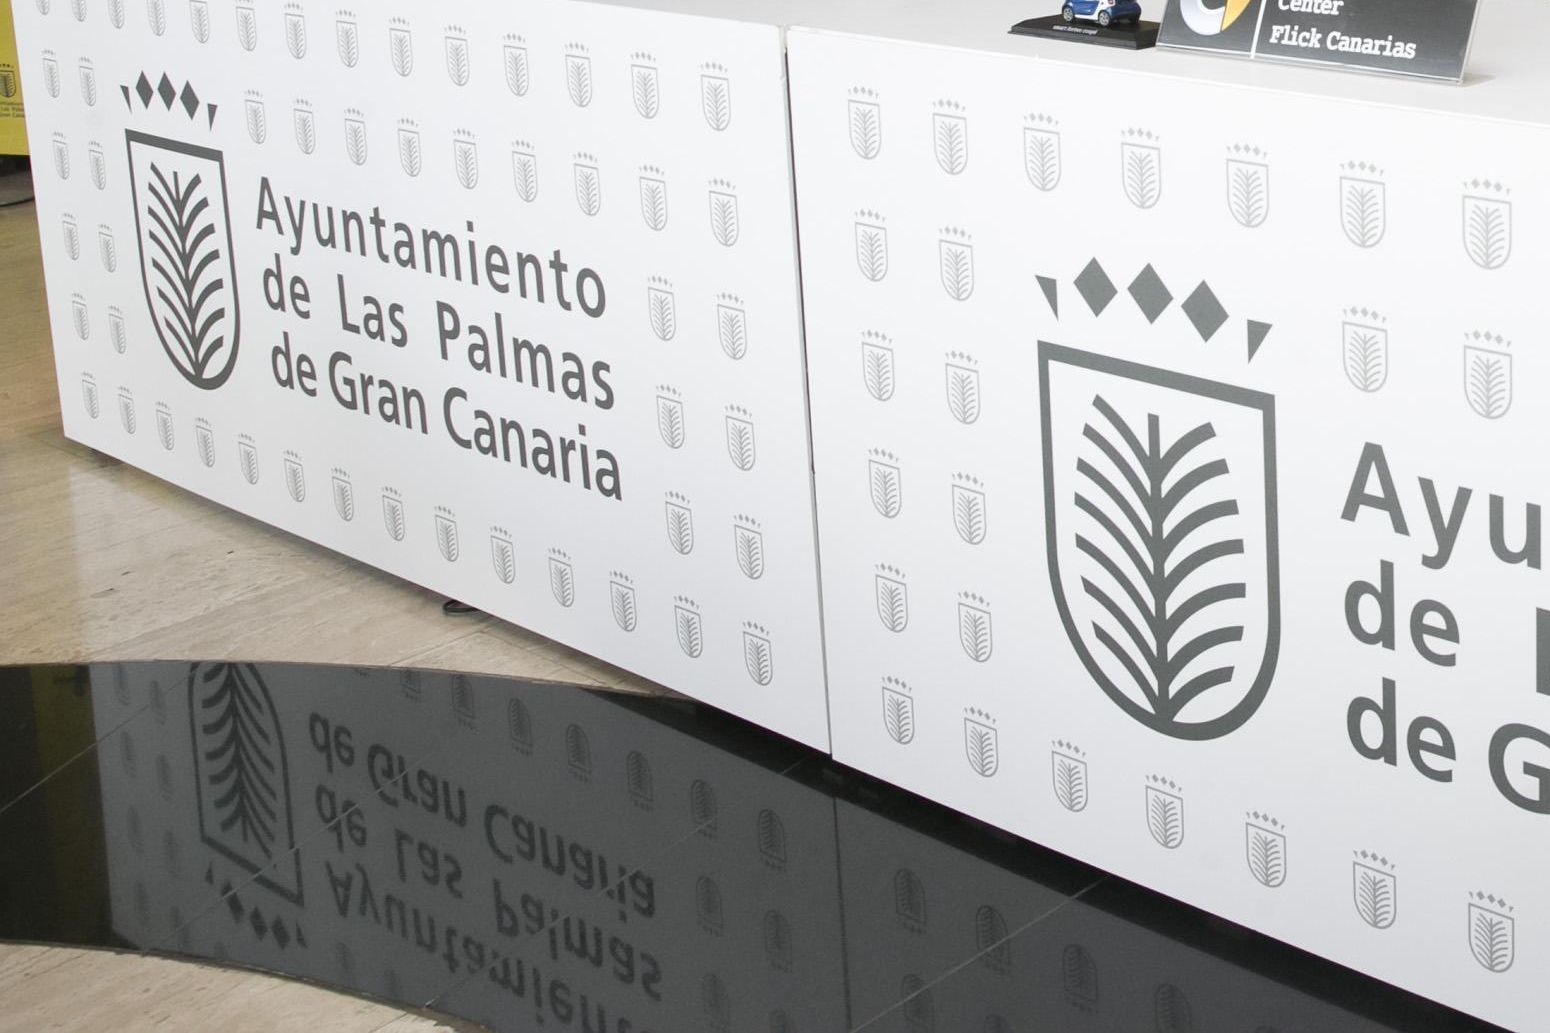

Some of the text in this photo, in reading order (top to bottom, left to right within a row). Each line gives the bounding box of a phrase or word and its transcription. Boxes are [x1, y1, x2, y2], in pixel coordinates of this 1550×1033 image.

[1269, 25, 1417, 60] Flick Canarias
[256, 176, 606, 318] Ayuntamiento
[263, 253, 615, 410] de Las Palmas
[271, 331, 622, 501] de Gran Canaria
[1344, 558, 1460, 667] de
[1346, 676, 1457, 783] de
